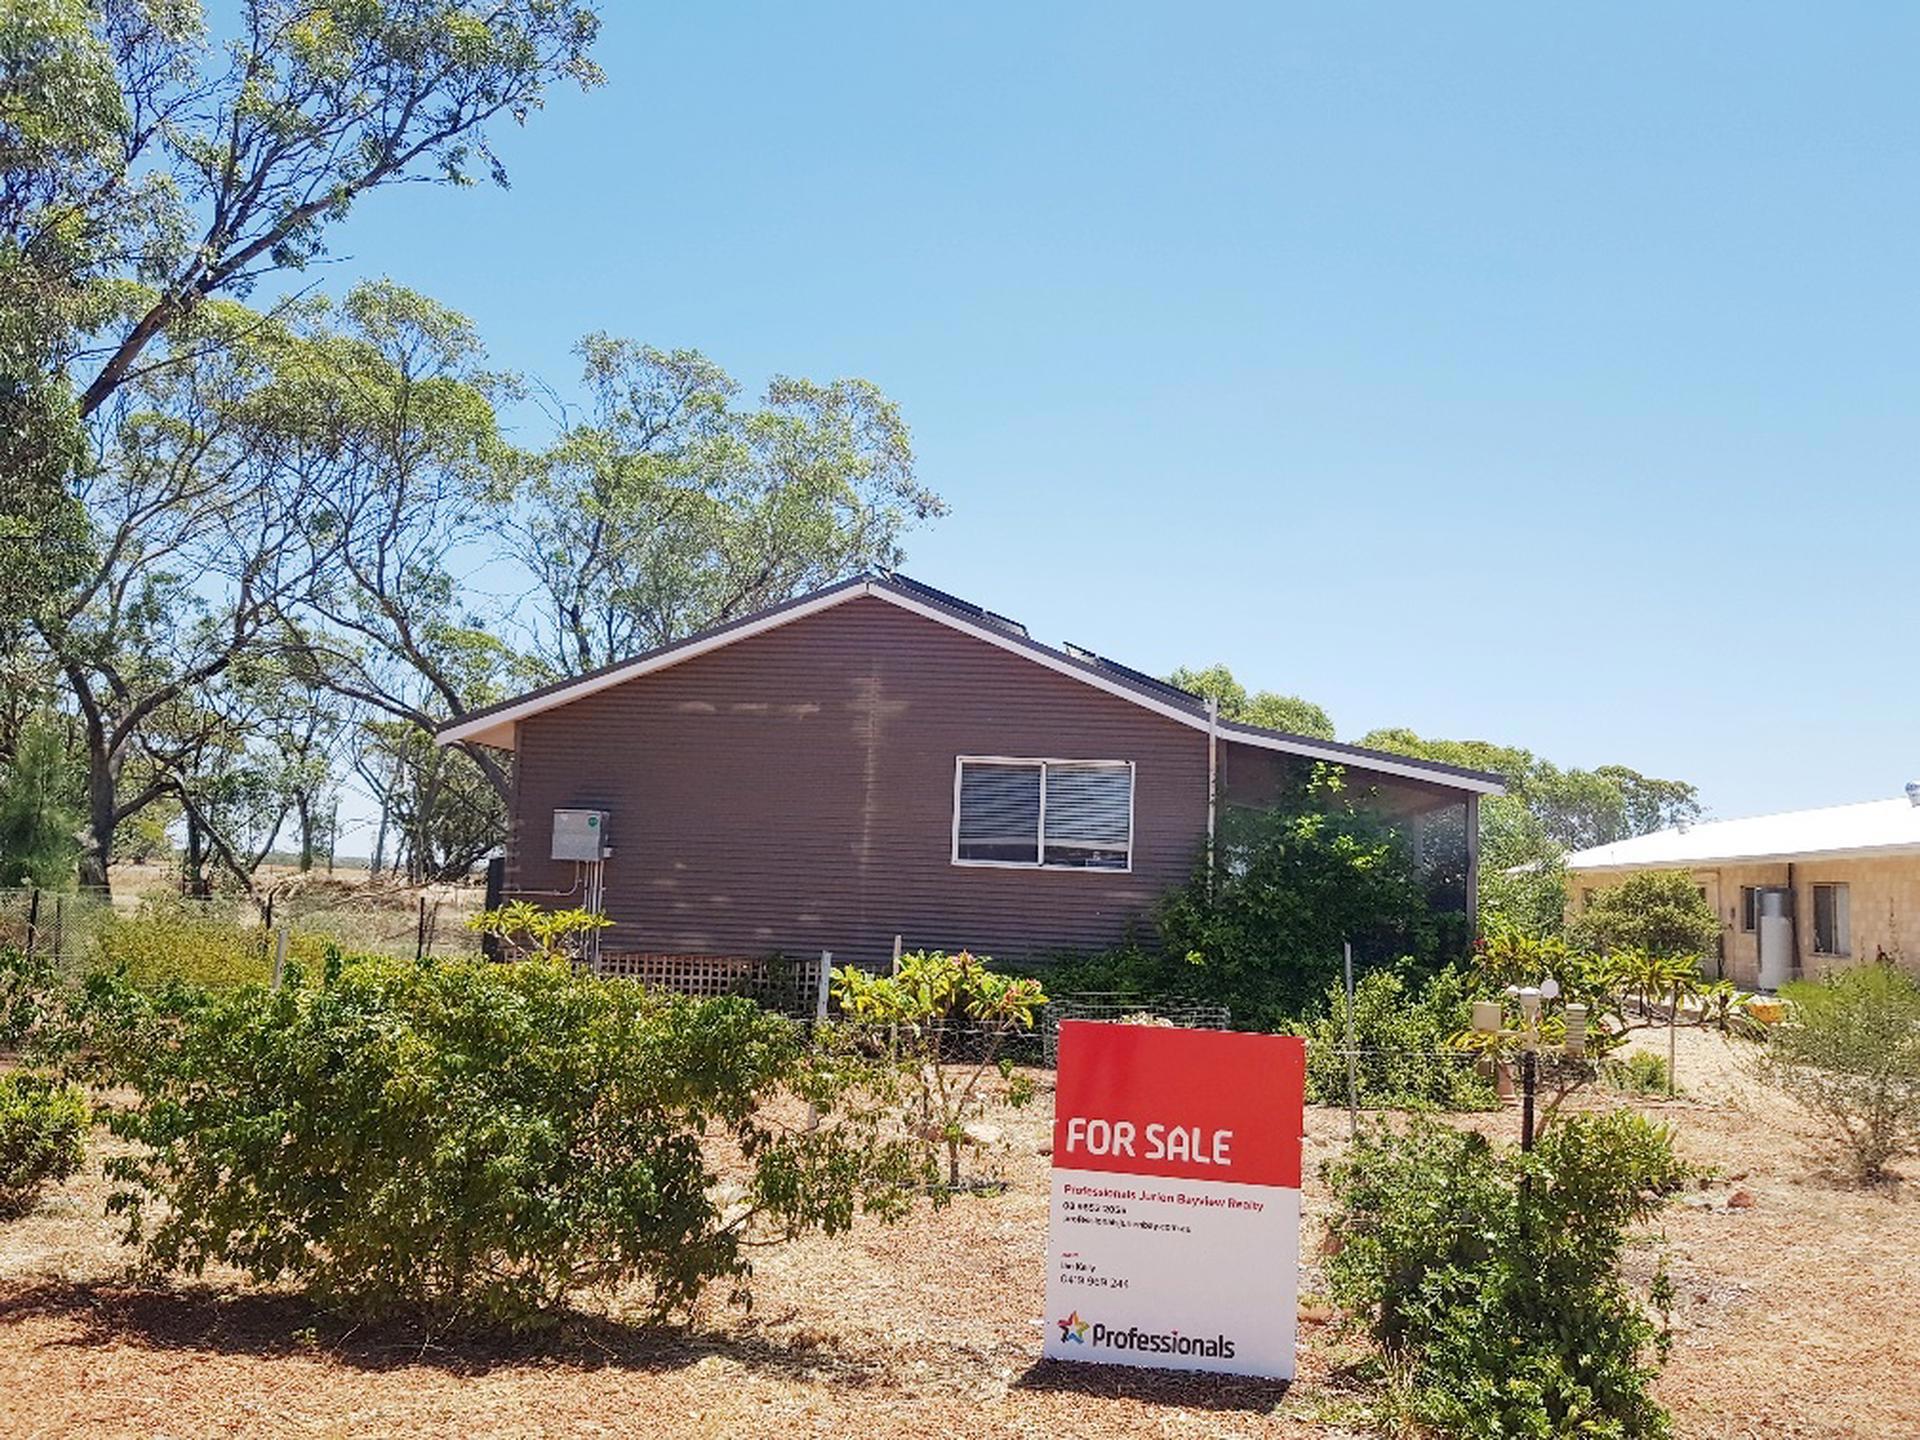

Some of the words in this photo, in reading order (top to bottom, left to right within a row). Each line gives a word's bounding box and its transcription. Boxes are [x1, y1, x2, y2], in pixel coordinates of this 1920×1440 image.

[1066, 1118, 1136, 1157] FOR
[1145, 1123, 1234, 1166] SALE
[1064, 1184, 1136, 1201] Professionals
[1092, 1323, 1236, 1360] Professionals
